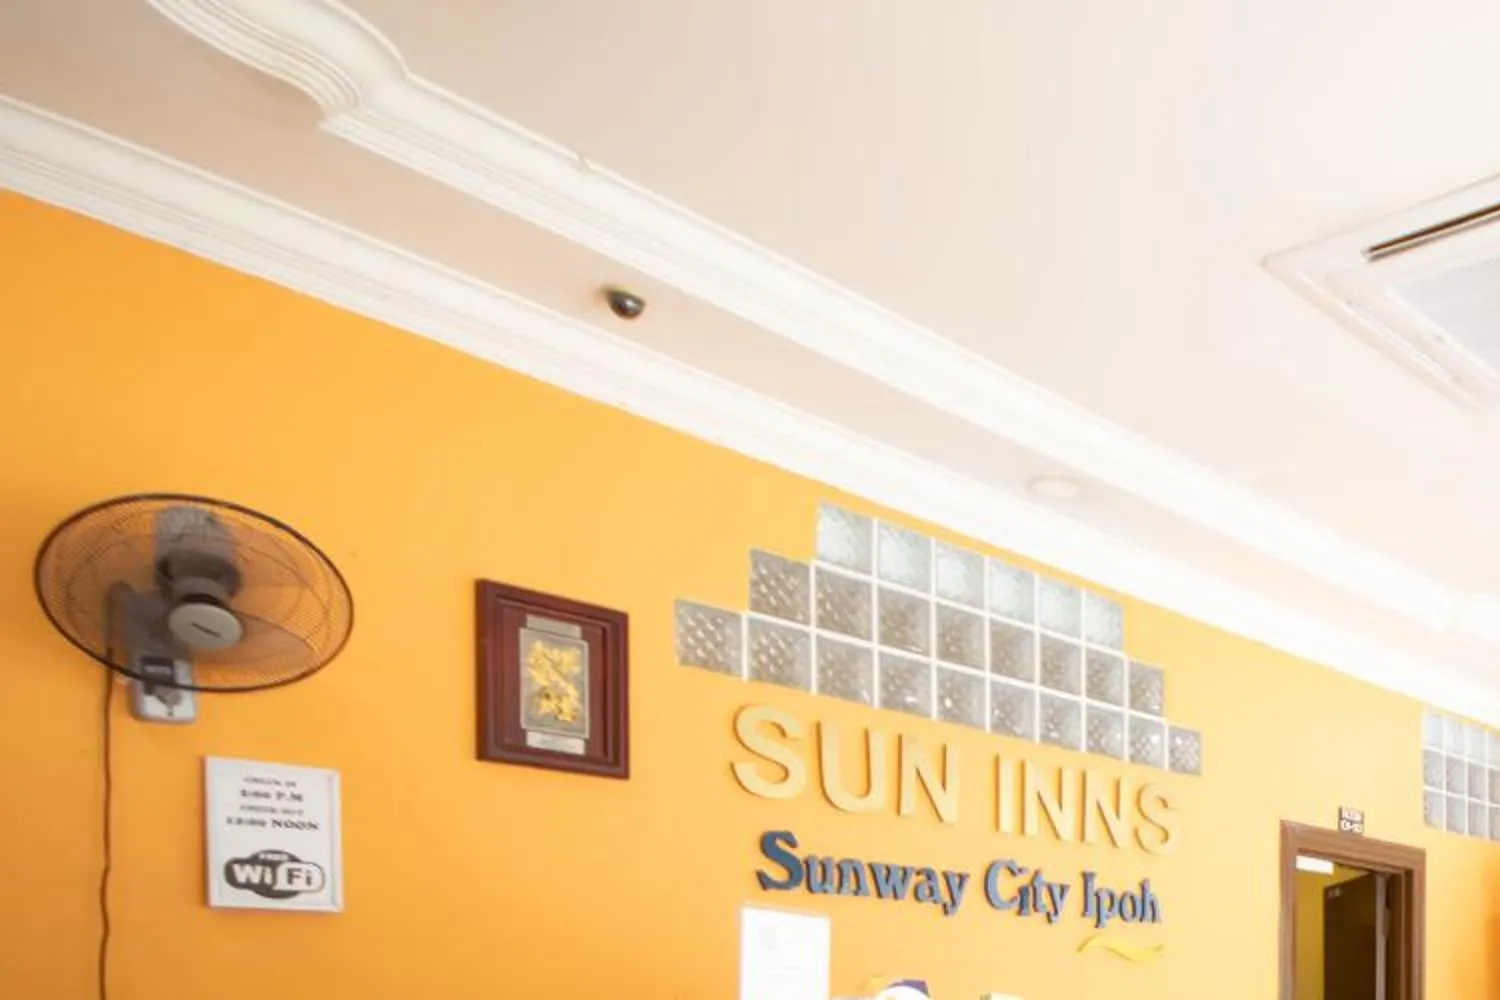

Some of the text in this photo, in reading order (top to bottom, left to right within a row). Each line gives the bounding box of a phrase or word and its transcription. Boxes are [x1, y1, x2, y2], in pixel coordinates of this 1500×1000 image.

[271, 819, 319, 830] NOON
[729, 702, 1182, 857] SUN INNS
[755, 829, 1162, 929] Sunway City Ipoh
